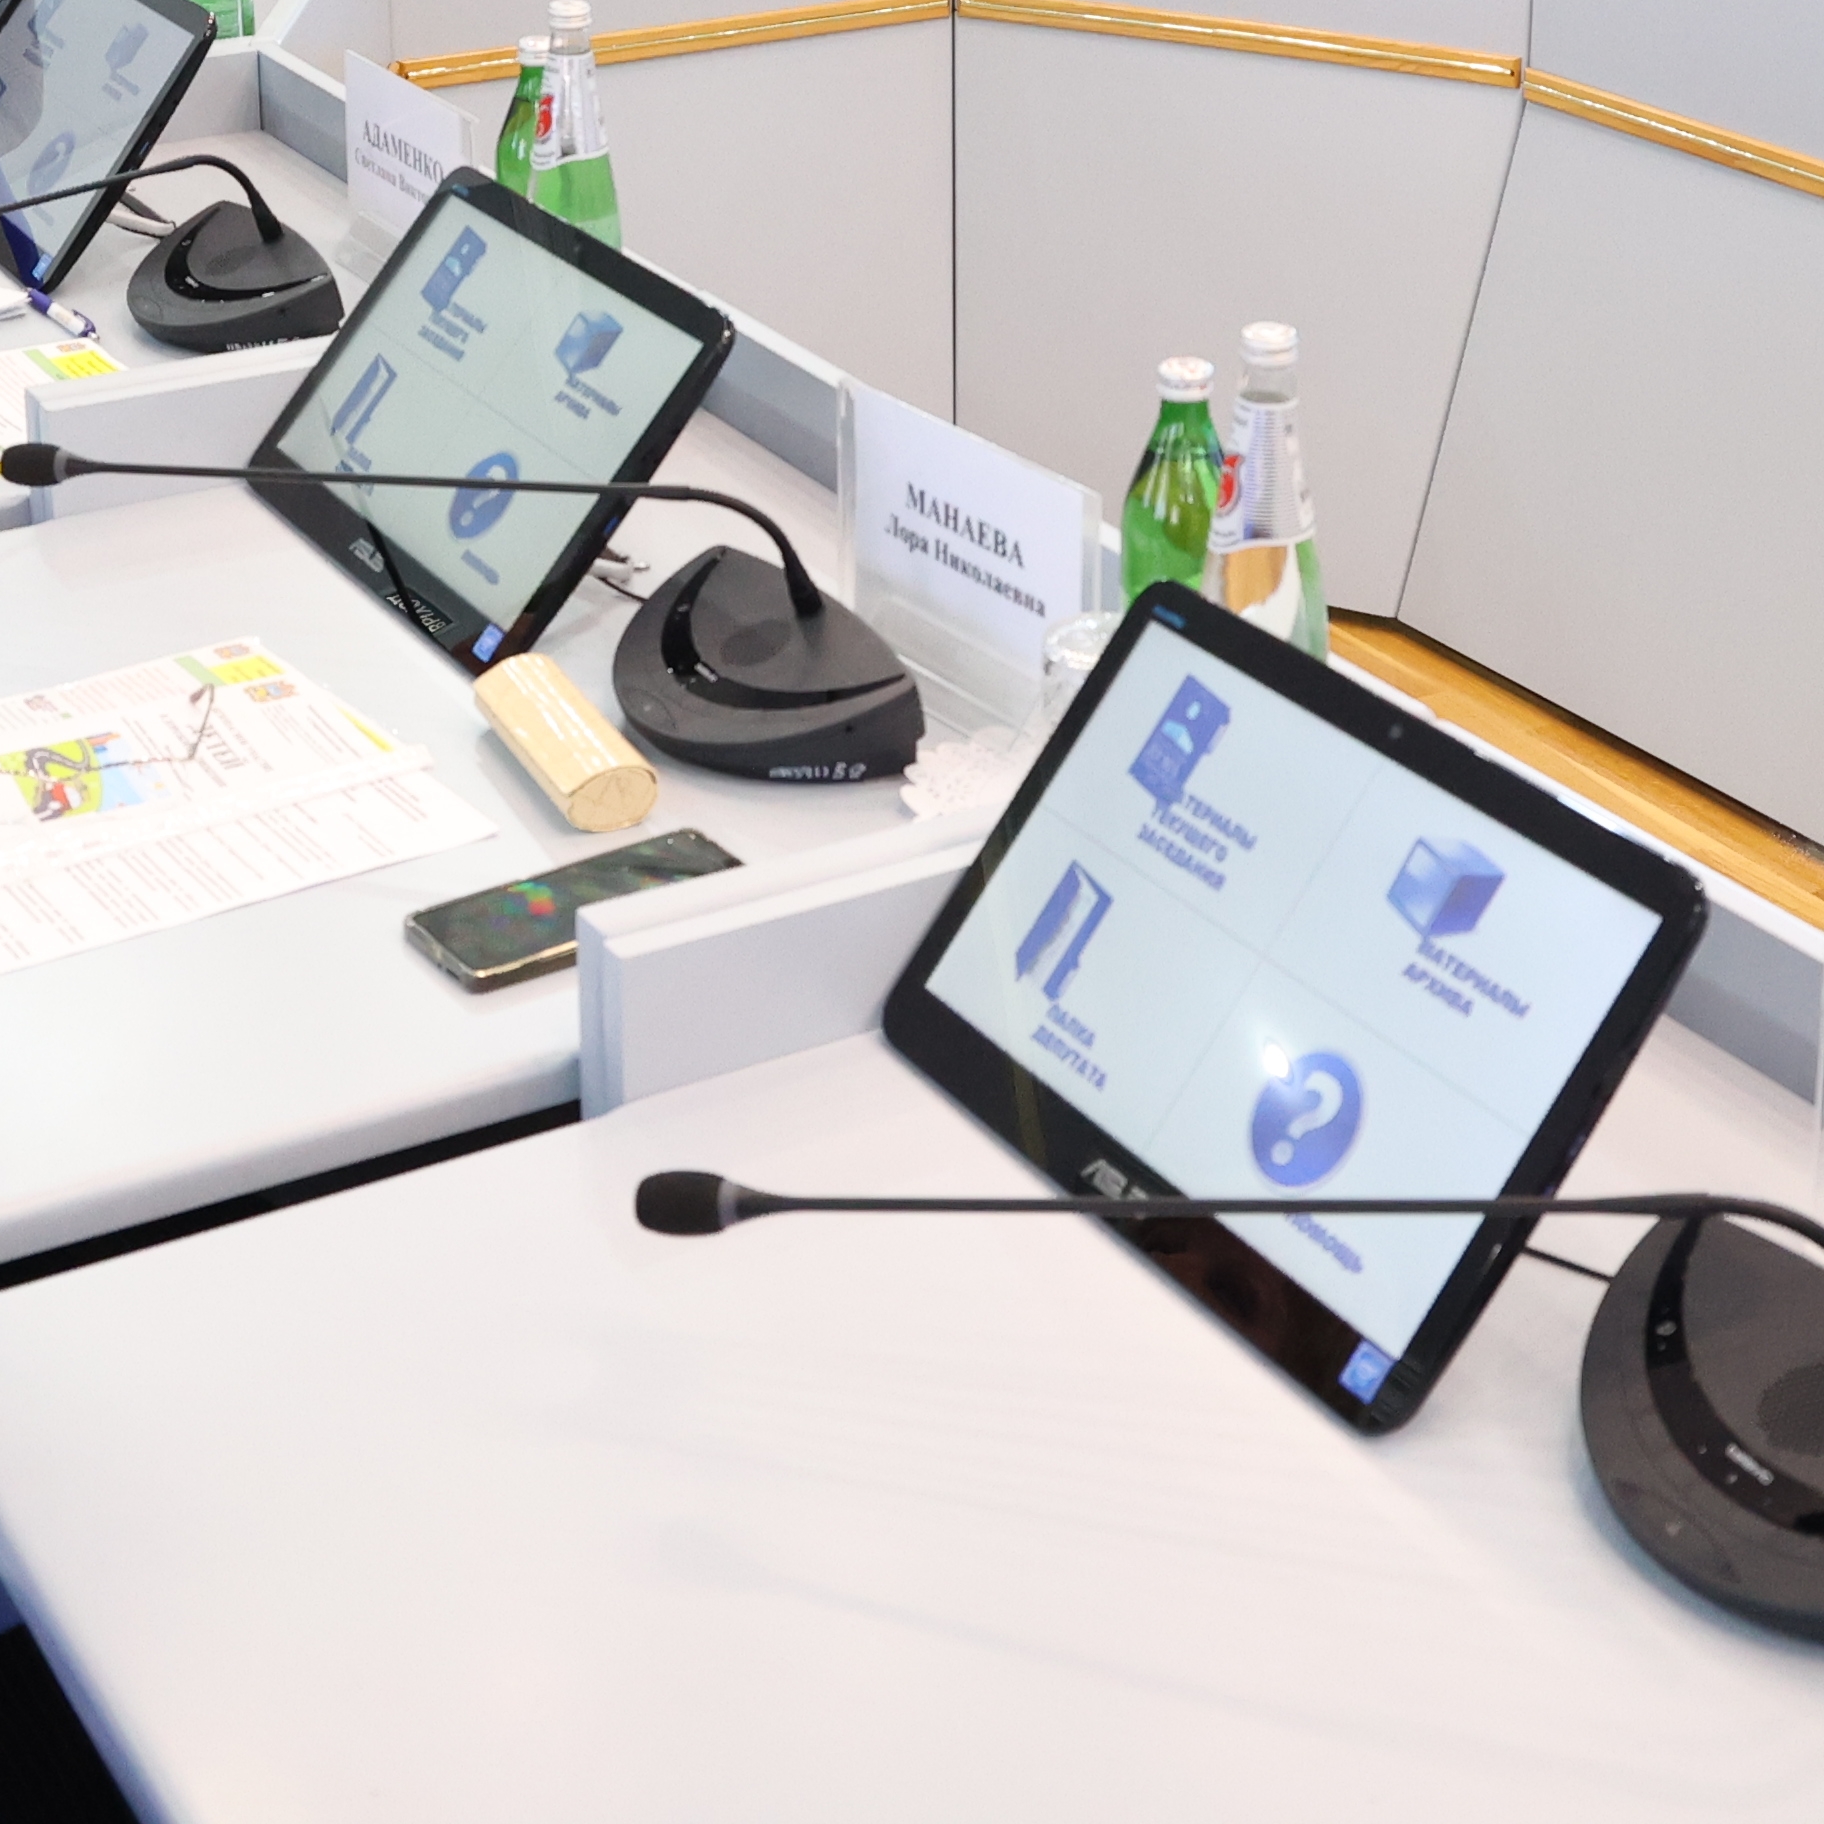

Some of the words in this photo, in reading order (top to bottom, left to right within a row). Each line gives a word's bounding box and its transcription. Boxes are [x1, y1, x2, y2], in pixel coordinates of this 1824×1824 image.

[362, 119, 444, 184] АДАМЕНКО
[884, 513, 929, 555] Лора
[934, 538, 1046, 618] Николаевна
[905, 481, 1025, 569] МАНАЕВА
